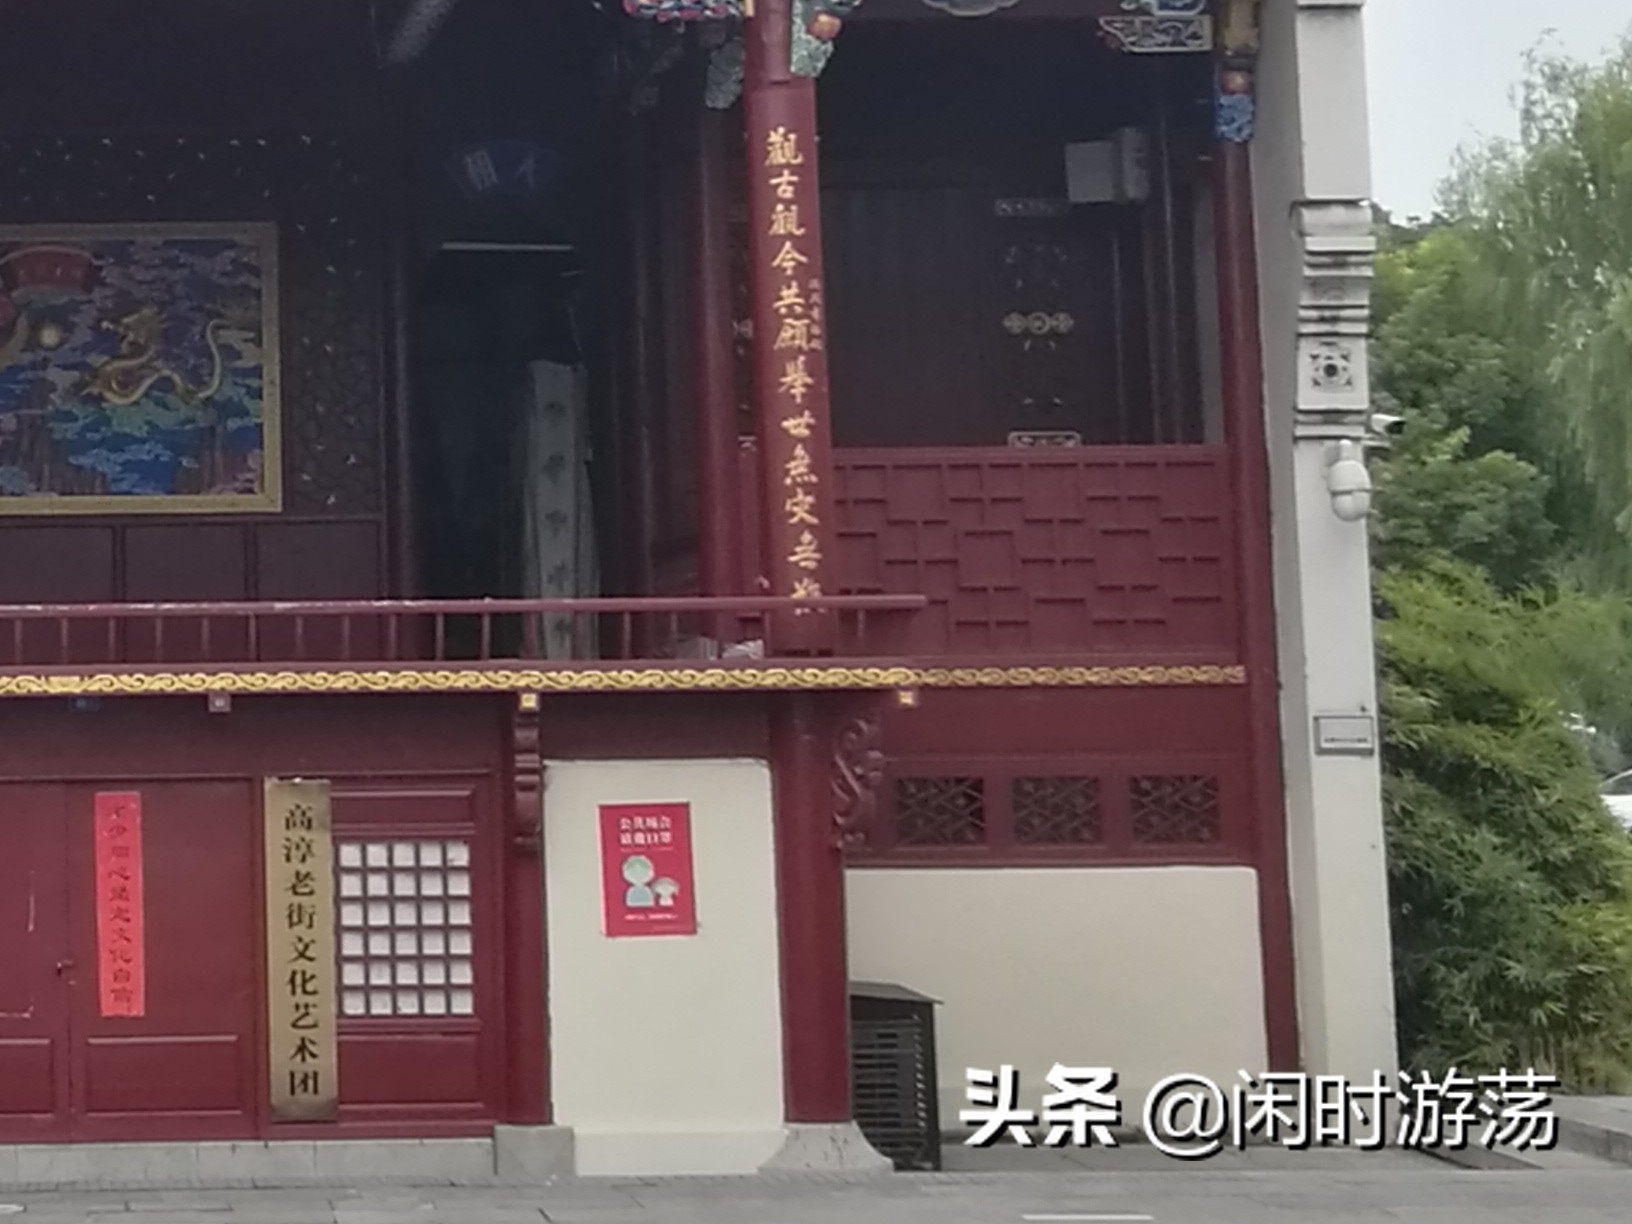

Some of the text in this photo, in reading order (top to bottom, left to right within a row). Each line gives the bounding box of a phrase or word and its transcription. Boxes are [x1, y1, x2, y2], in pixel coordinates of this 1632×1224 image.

[282, 803, 319, 1097] 高淳老街文化艺术团
